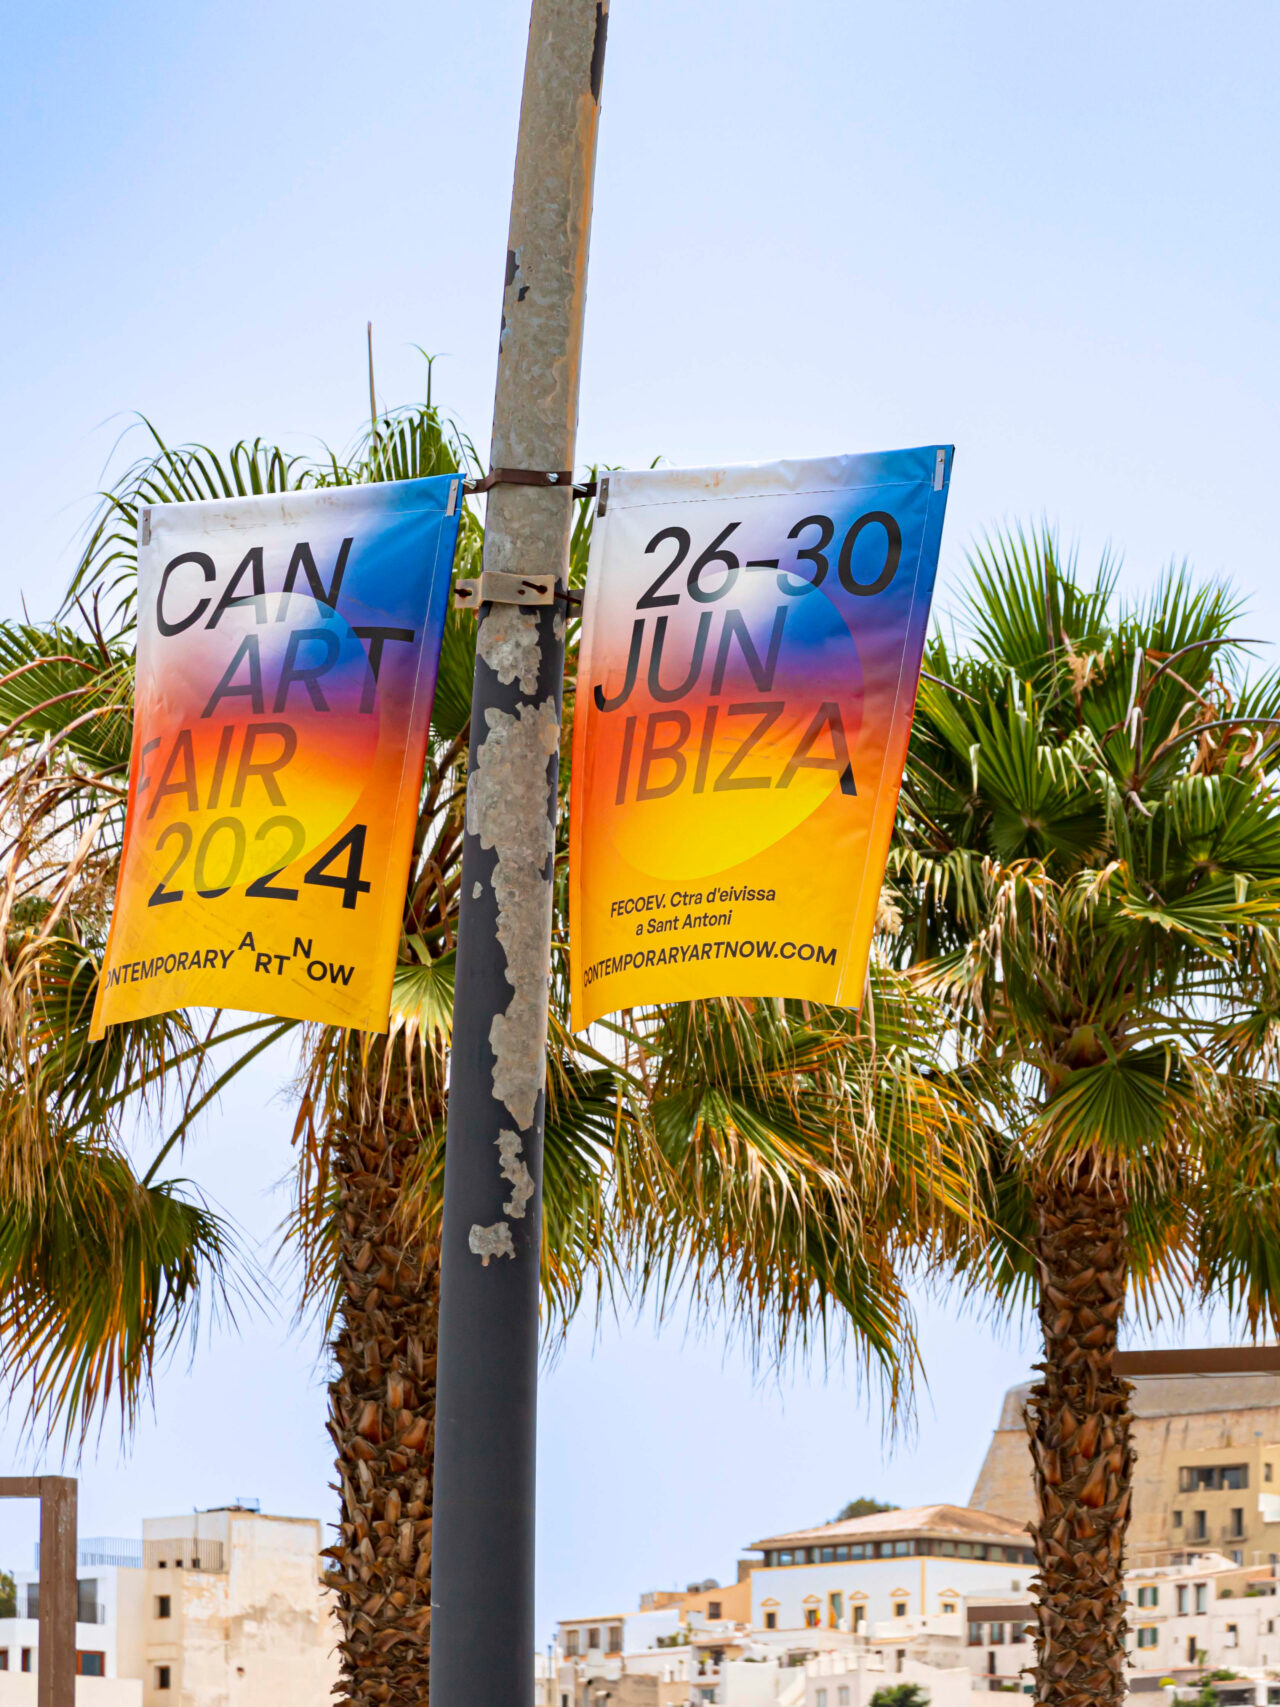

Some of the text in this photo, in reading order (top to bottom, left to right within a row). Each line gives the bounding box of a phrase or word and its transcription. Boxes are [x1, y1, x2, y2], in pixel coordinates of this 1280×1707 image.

[157, 537, 354, 637] CAN
[201, 626, 415, 719] ART
[594, 605, 788, 713] JUN
[615, 701, 857, 805] IBIZA
[148, 815, 371, 910] 2024
[610, 885, 776, 918] FECOEV. Ctra d'eivissa
[583, 940, 838, 988] CONTEMPORARYARTNOW.COM
[635, 910, 733, 936] a Sant Antoni
